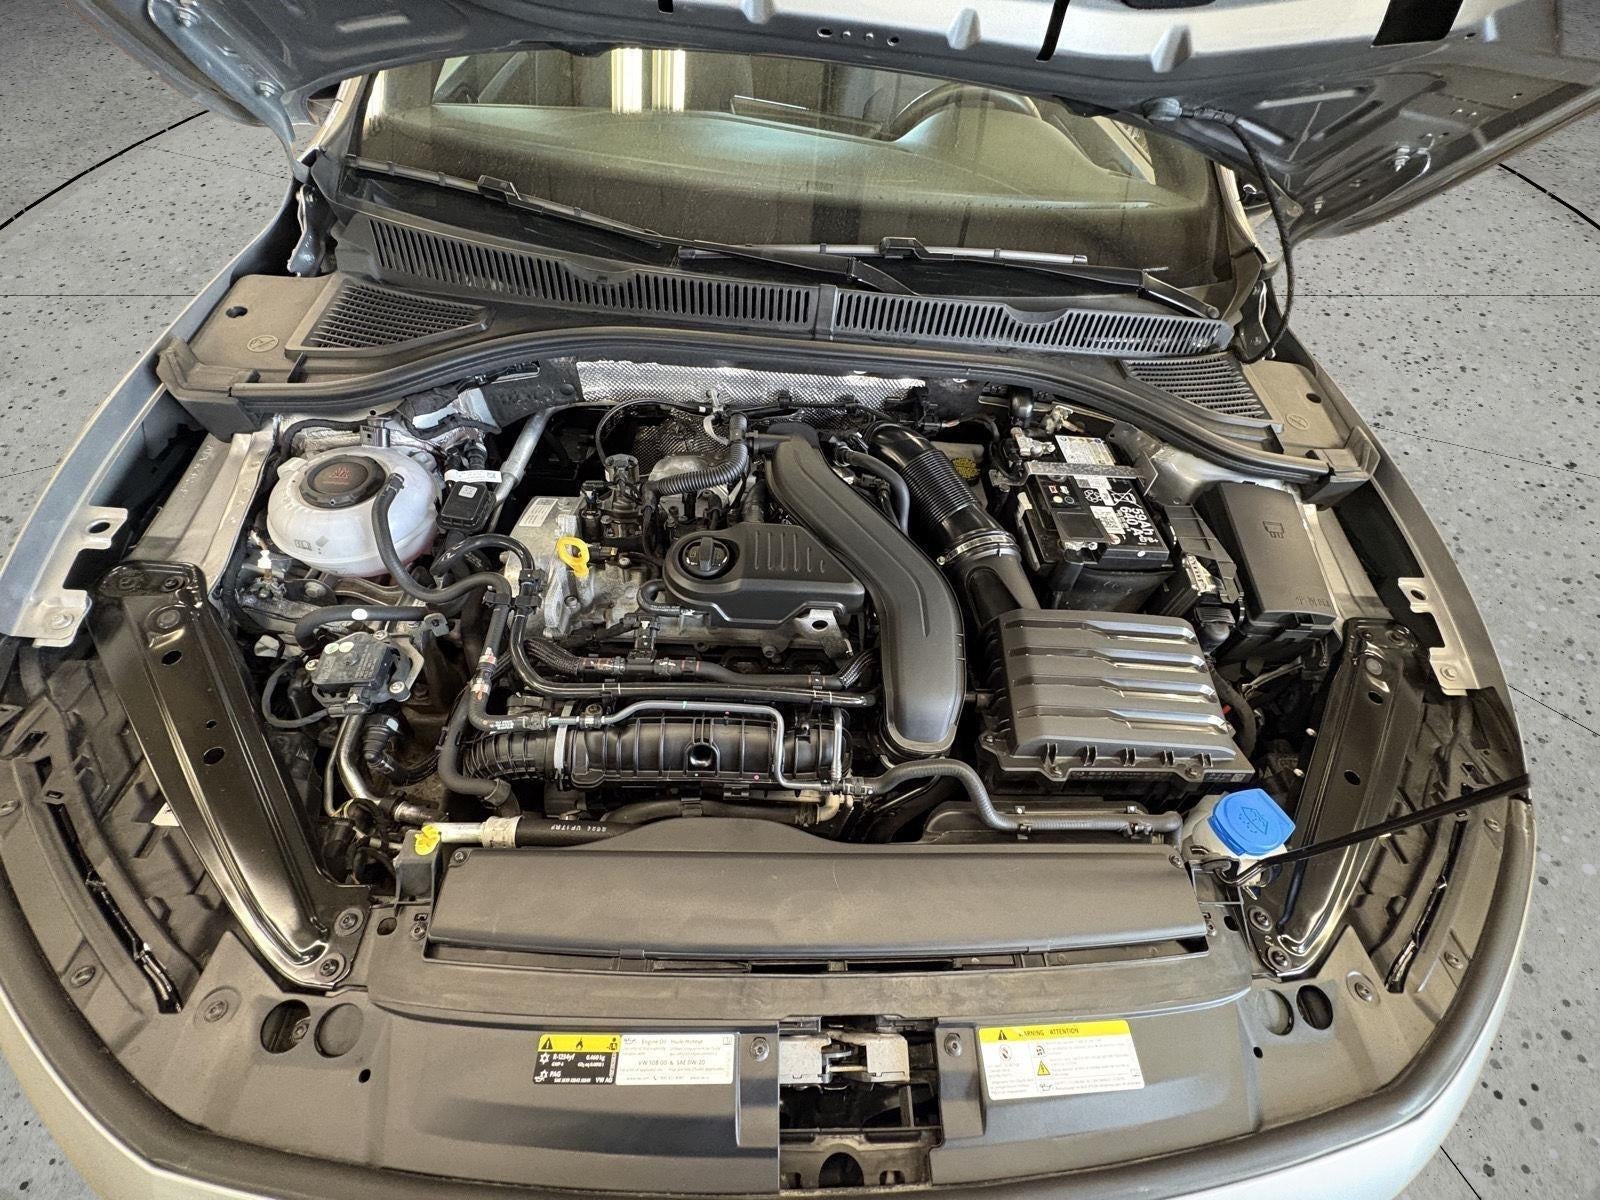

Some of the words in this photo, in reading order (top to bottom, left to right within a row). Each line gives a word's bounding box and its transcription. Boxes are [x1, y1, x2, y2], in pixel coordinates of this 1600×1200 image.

[1120, 506, 1138, 525] 640
[1018, 1029, 1045, 1037] ARNING
[1049, 1027, 1080, 1036] ATTENTION
